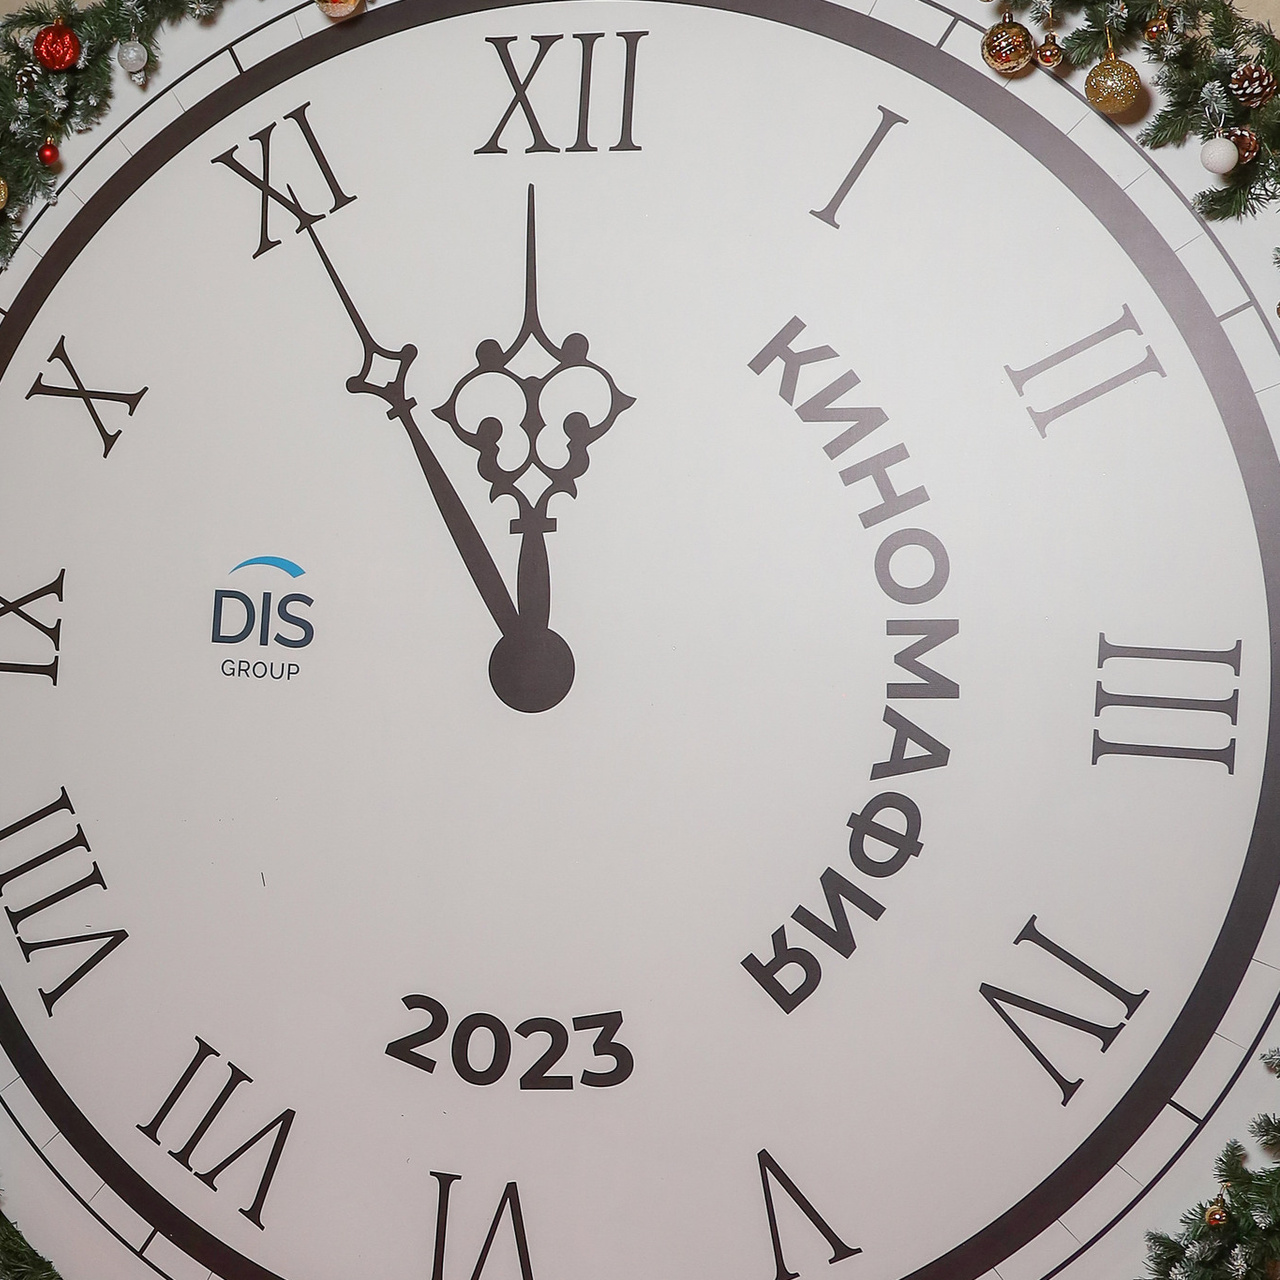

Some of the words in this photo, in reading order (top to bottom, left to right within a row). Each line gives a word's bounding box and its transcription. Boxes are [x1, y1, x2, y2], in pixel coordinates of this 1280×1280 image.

[473, 30, 650, 155] XII
[210, 101, 358, 260] XI
[808, 104, 910, 230] I
[24, 334, 149, 459] X
[1004, 303, 1167, 439] II
[211, 589, 315, 649] DIS
[221, 659, 300, 681] GROUP
[739, 314, 960, 1016] КИНОМАФИЯ
[1091, 632, 1243, 776] III
[384, 993, 635, 1091] 2023
[978, 914, 1151, 1108] IV
[135, 1035, 297, 1231] VII
